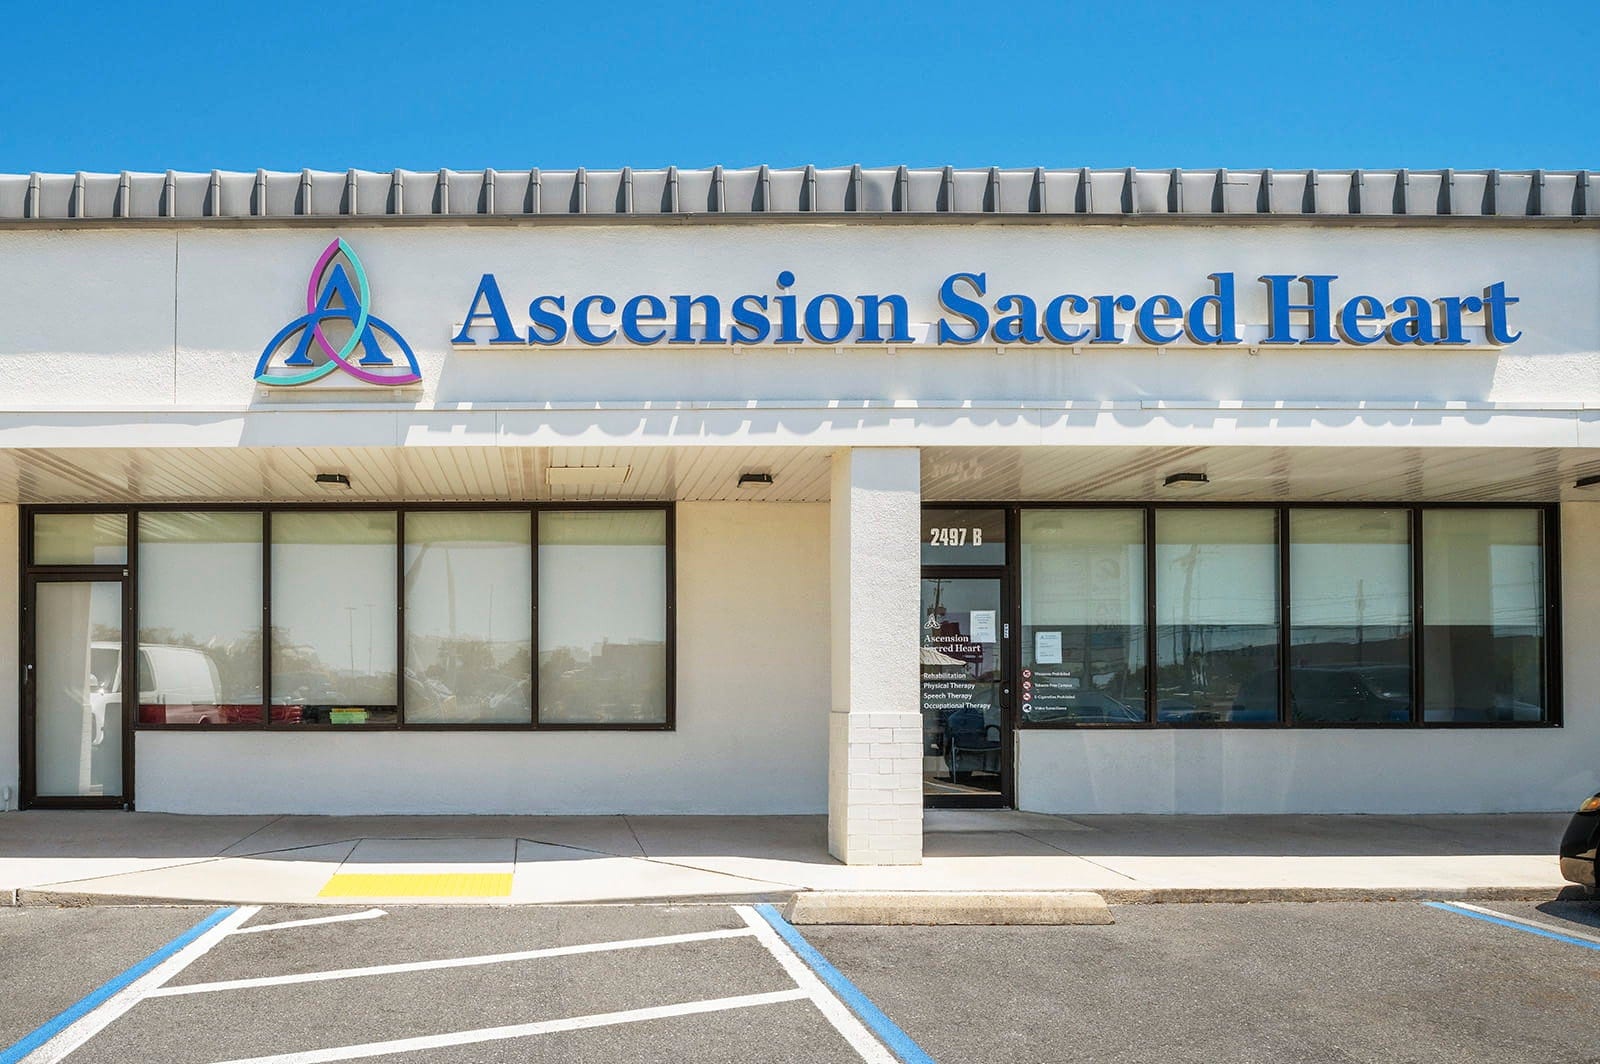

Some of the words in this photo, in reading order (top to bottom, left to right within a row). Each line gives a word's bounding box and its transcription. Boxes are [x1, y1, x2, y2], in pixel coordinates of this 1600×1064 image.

[452, 271, 912, 345] Ascension
[940, 272, 1241, 345] Sacred
[1264, 275, 1521, 345] Heart
[930, 528, 967, 546] 2497
[973, 528, 982, 546] B
[924, 634, 969, 643] Ascension
[955, 644, 981, 653] Heart
[923, 682, 949, 690] Physical
[950, 682, 976, 690] Therapy
[923, 692, 947, 700] Speech
[947, 692, 973, 701] Therapy
[923, 702, 965, 710] Occupational
[965, 702, 992, 710] Therapy
